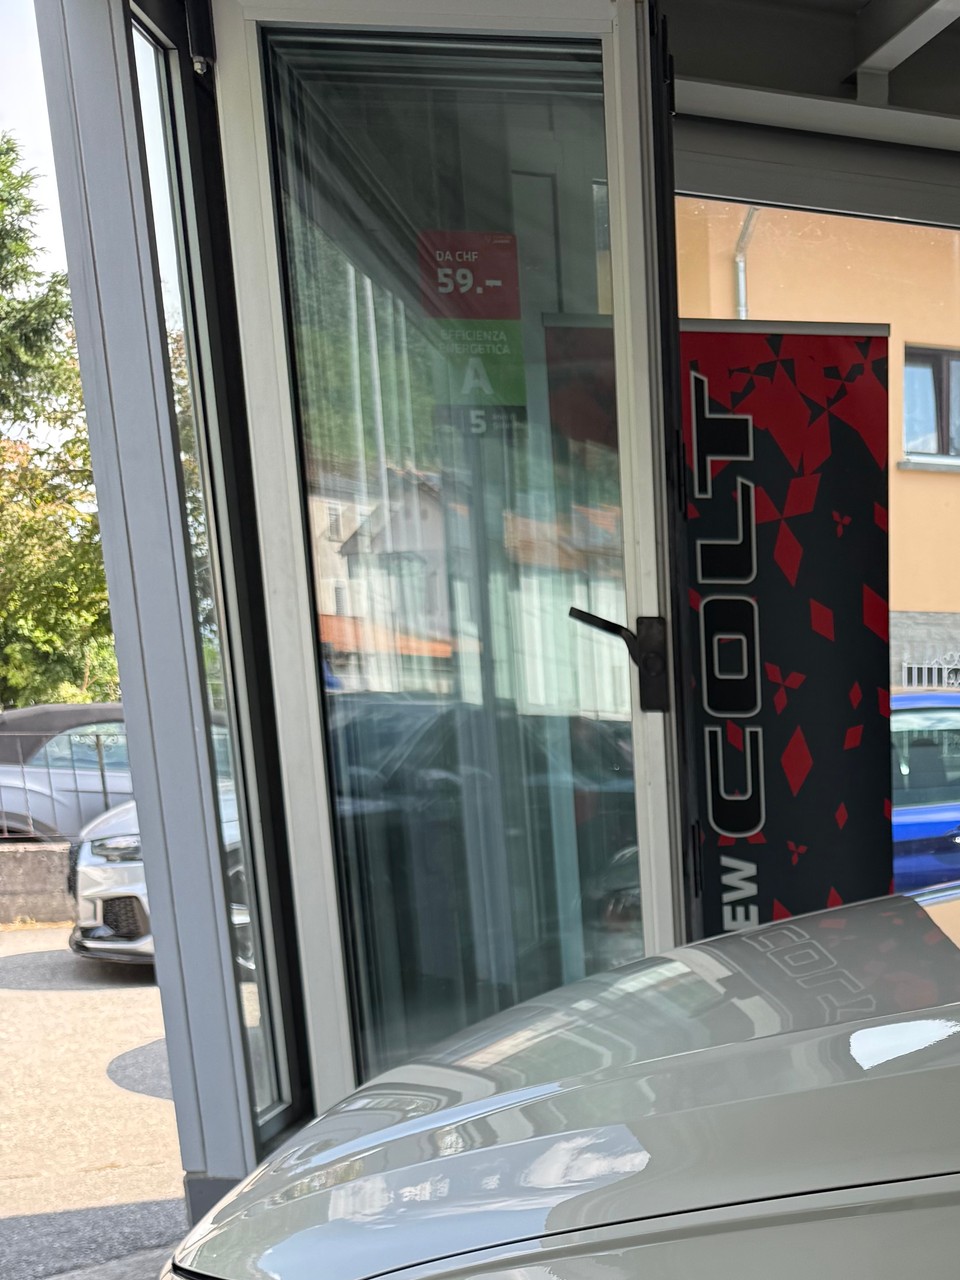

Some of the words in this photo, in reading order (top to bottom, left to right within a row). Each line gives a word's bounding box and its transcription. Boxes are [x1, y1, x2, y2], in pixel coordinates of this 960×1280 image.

[435, 250, 453, 262] DA
[455, 250, 479, 262] CHF
[461, 357, 494, 395] A
[469, 410, 487, 434] 5
[690, 370, 766, 838] COLT
[721, 856, 759, 931] EW
